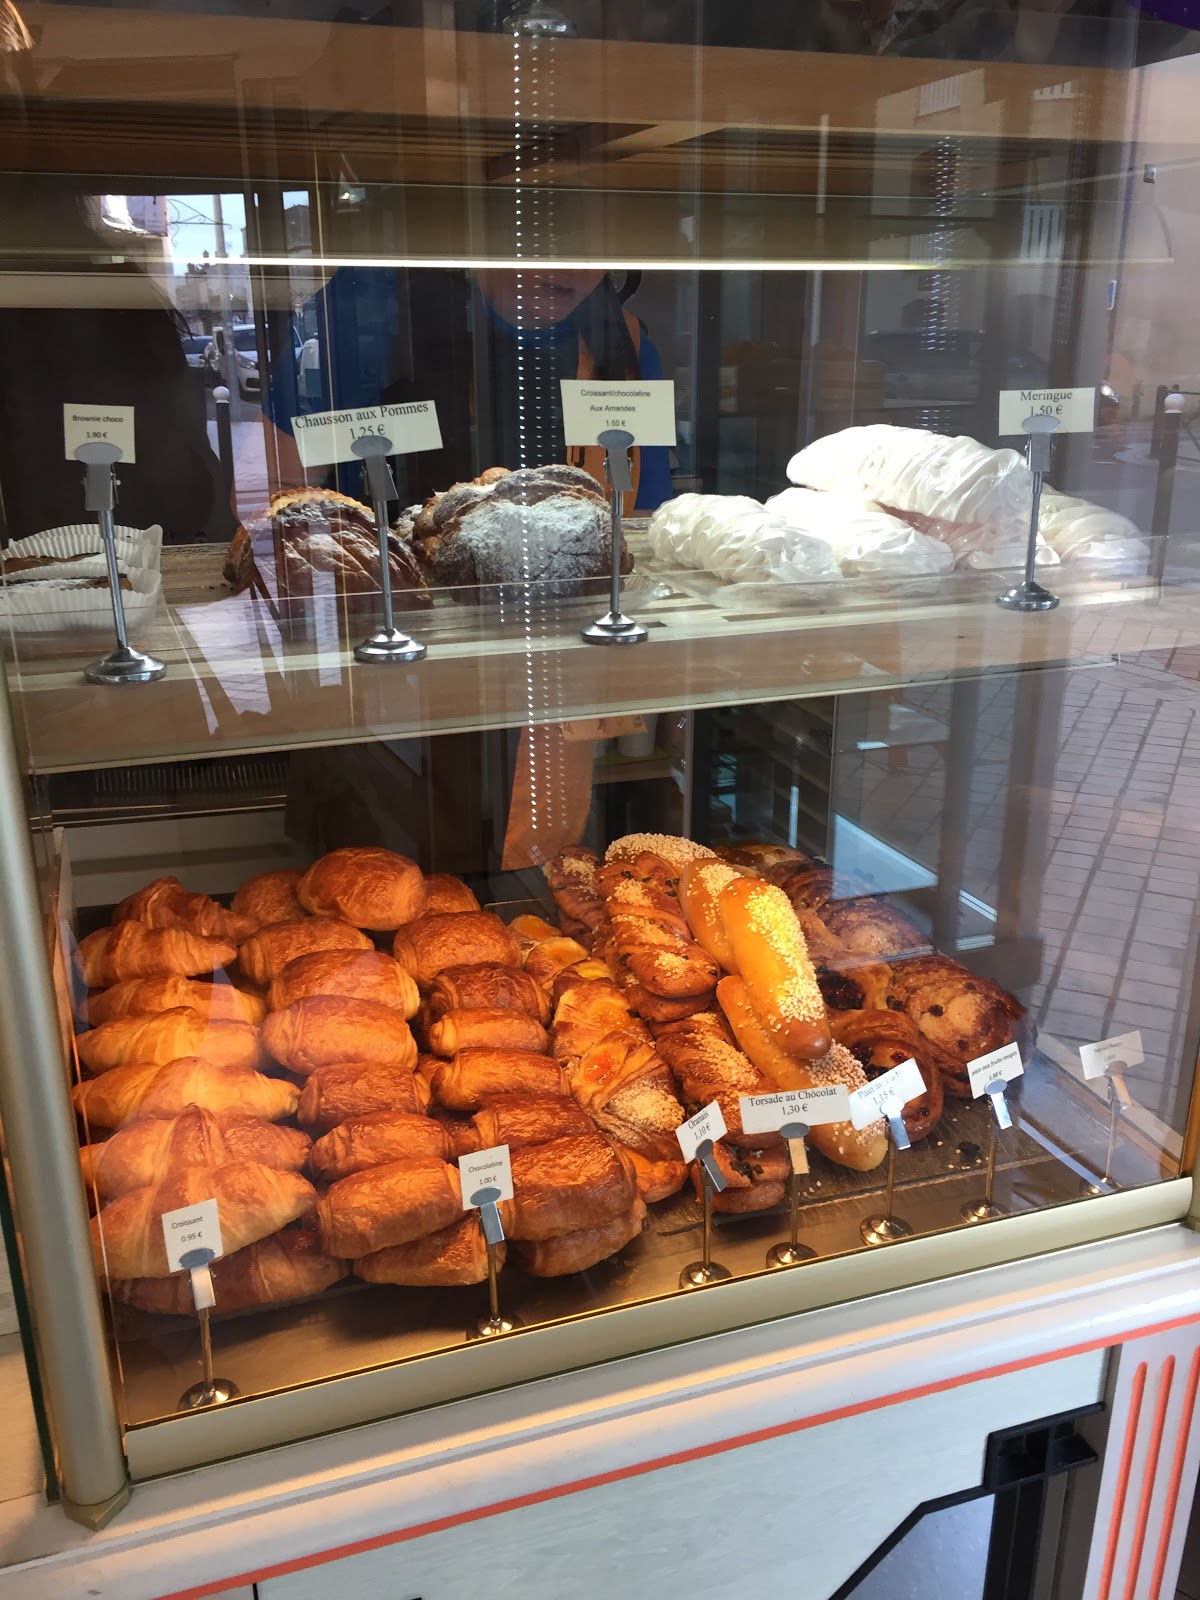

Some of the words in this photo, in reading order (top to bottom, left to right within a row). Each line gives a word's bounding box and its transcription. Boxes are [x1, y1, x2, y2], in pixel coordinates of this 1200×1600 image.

[1020, 390, 1073, 403] Meringue
[295, 413, 353, 430] Chausson
[356, 410, 378, 422] aux
[380, 402, 429, 418] Pommes
[1055, 404, 1064, 415] €
[72, 414, 102, 423] Brownie
[102, 431, 108, 439] €
[377, 423, 386, 436] €
[748, 1094, 784, 1107] Torsade
[797, 1087, 838, 1100] Chocolat
[889, 1086, 895, 1096] €
[781, 1104, 801, 1116] 1,30
[801, 1103, 809, 1112] €
[688, 1110, 709, 1130] Oranais
[705, 1121, 712, 1131] €
[468, 1160, 503, 1173] Chocolatine
[171, 1216, 204, 1230] Croissant
